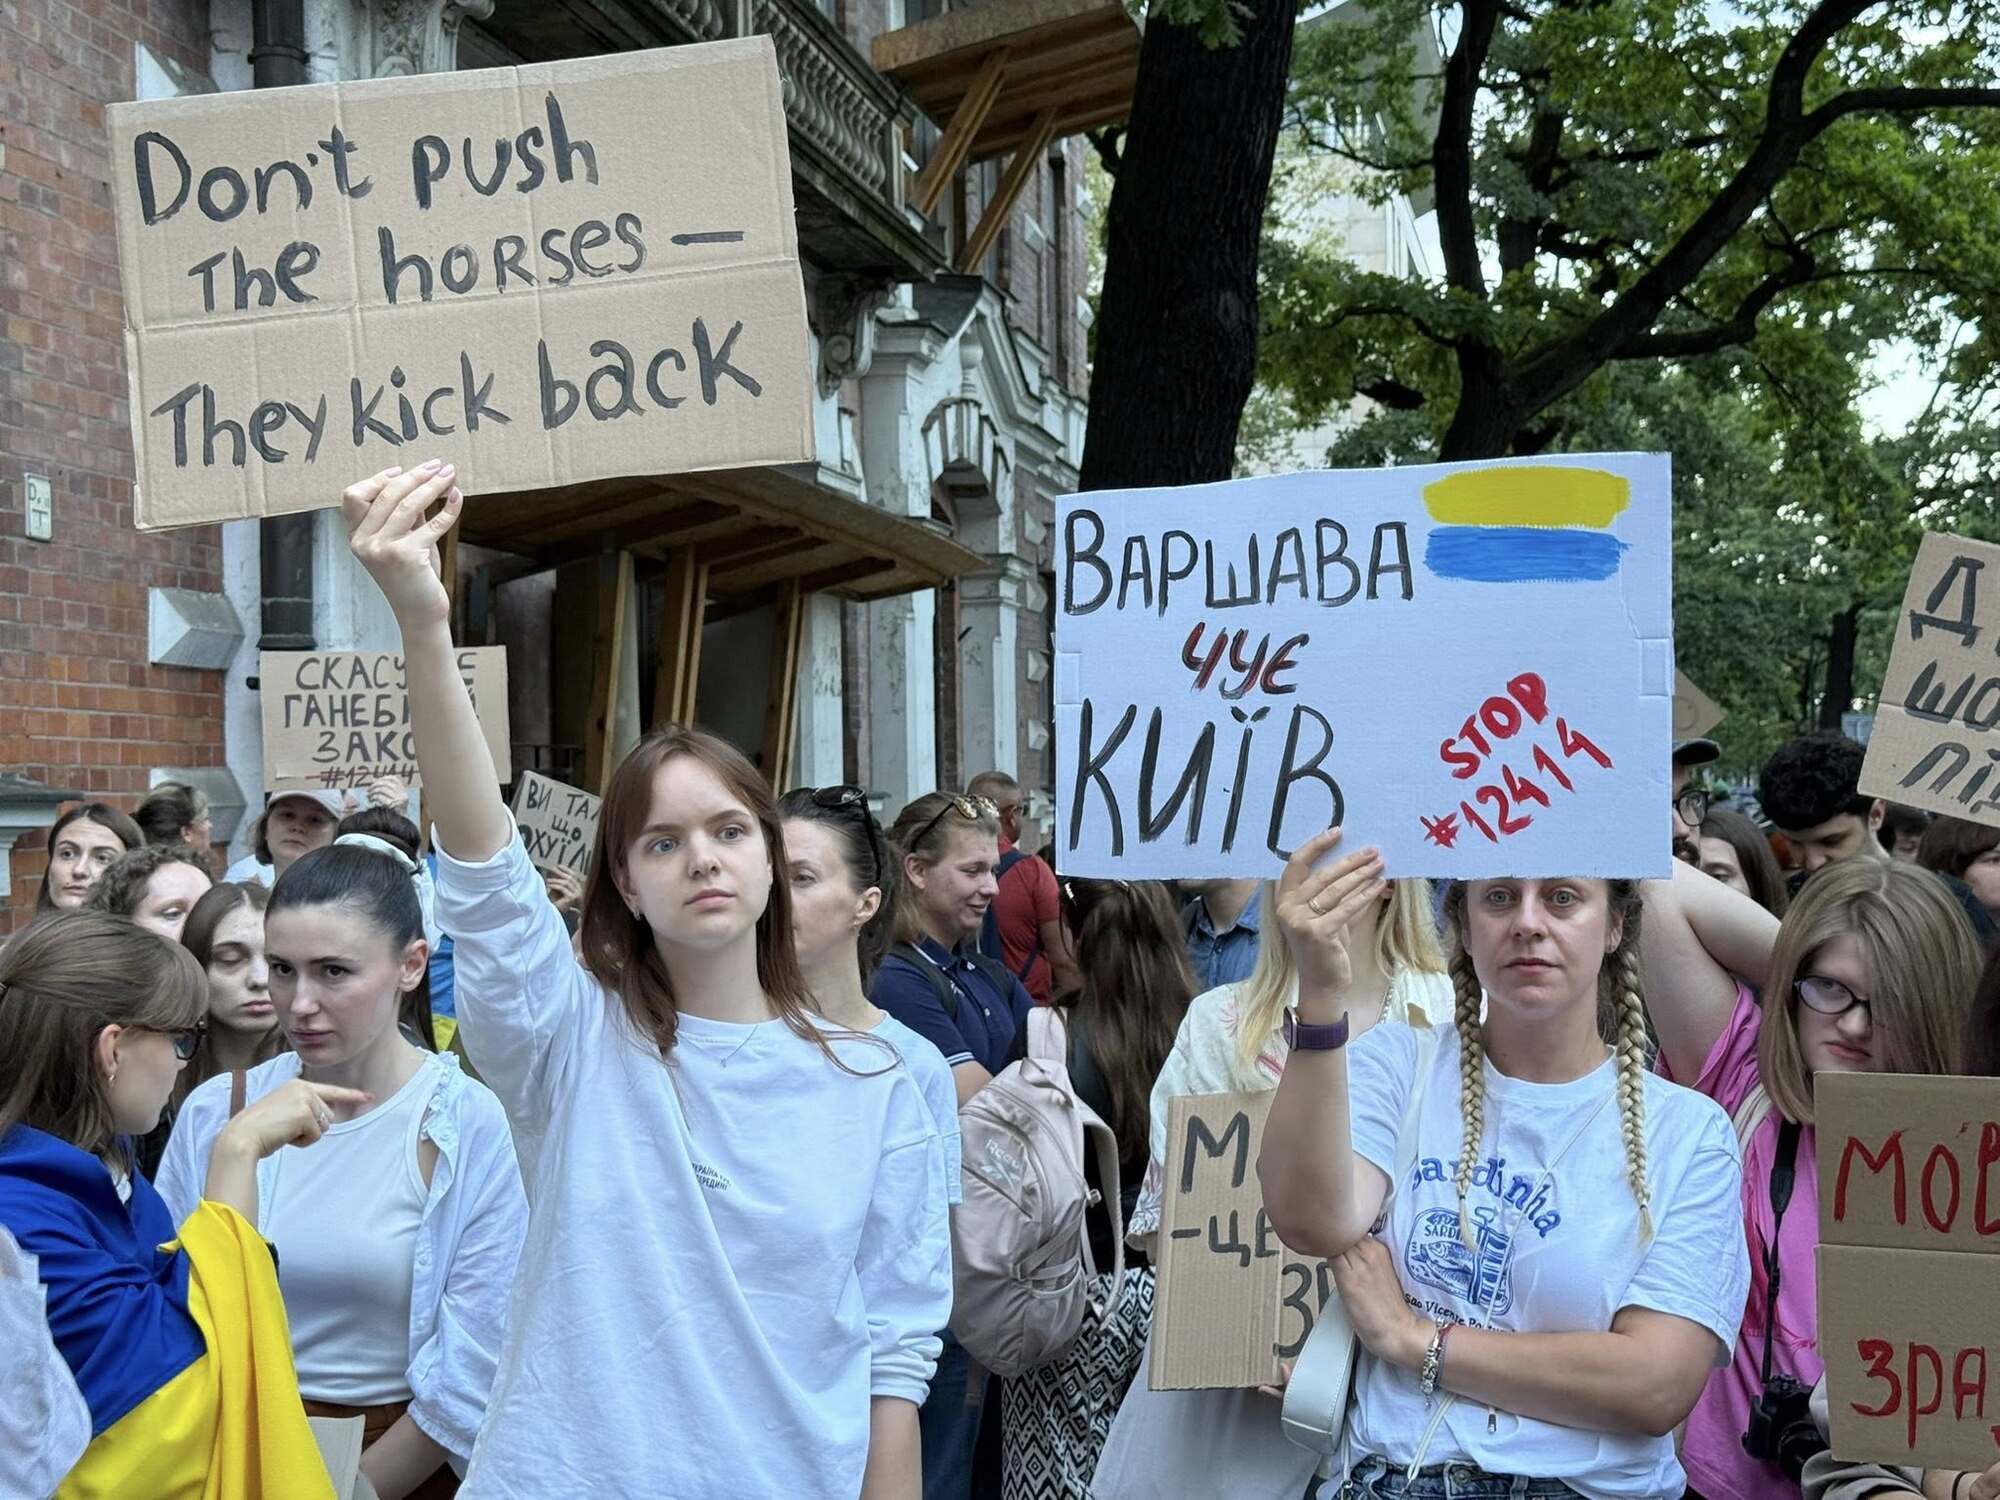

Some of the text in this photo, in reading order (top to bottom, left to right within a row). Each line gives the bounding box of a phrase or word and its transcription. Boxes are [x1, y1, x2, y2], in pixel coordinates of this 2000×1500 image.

[134, 90, 600, 226] Don't push
[188, 240, 321, 313] The
[151, 317, 762, 470] They kick back
[1064, 509, 1414, 617] ВАРШАВА
[296, 651, 478, 691] СКАСУЕ
[1181, 621, 1310, 700] ЧУЄ
[312, 730, 416, 763] ЗАКО
[1440, 672, 1550, 779] STOP
[526, 779, 553, 812] ВИ
[1069, 697, 1345, 862] КИЇВ
[1419, 716, 1615, 849] #12414
[1849, 1337, 2000, 1451] ЗРА
